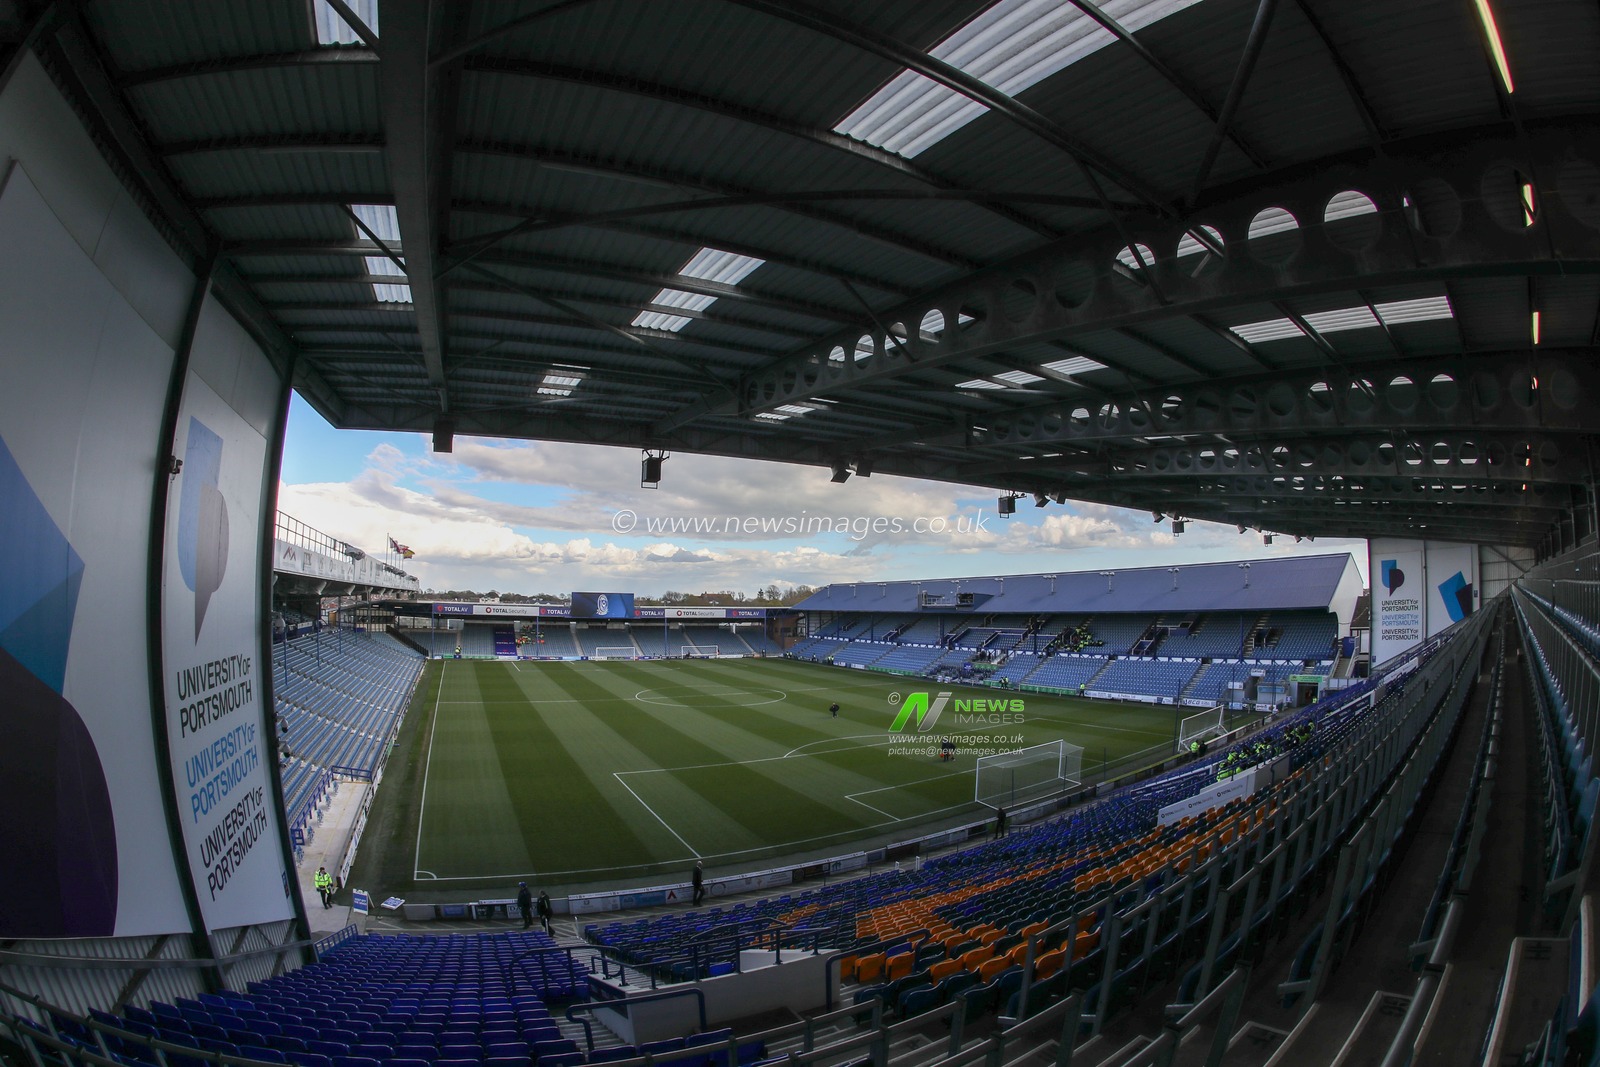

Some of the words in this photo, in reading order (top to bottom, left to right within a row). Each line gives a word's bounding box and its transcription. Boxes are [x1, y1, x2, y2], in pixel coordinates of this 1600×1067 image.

[176, 654, 243, 701] UNIVERSITY
[179, 679, 252, 737] PORTSMOUTH
[185, 722, 248, 788] UNIVERSITY
[191, 745, 259, 824] PORTSMOUTH
[200, 787, 256, 869] UNIVERSITY
[207, 807, 268, 902] PORTSMOUTH
